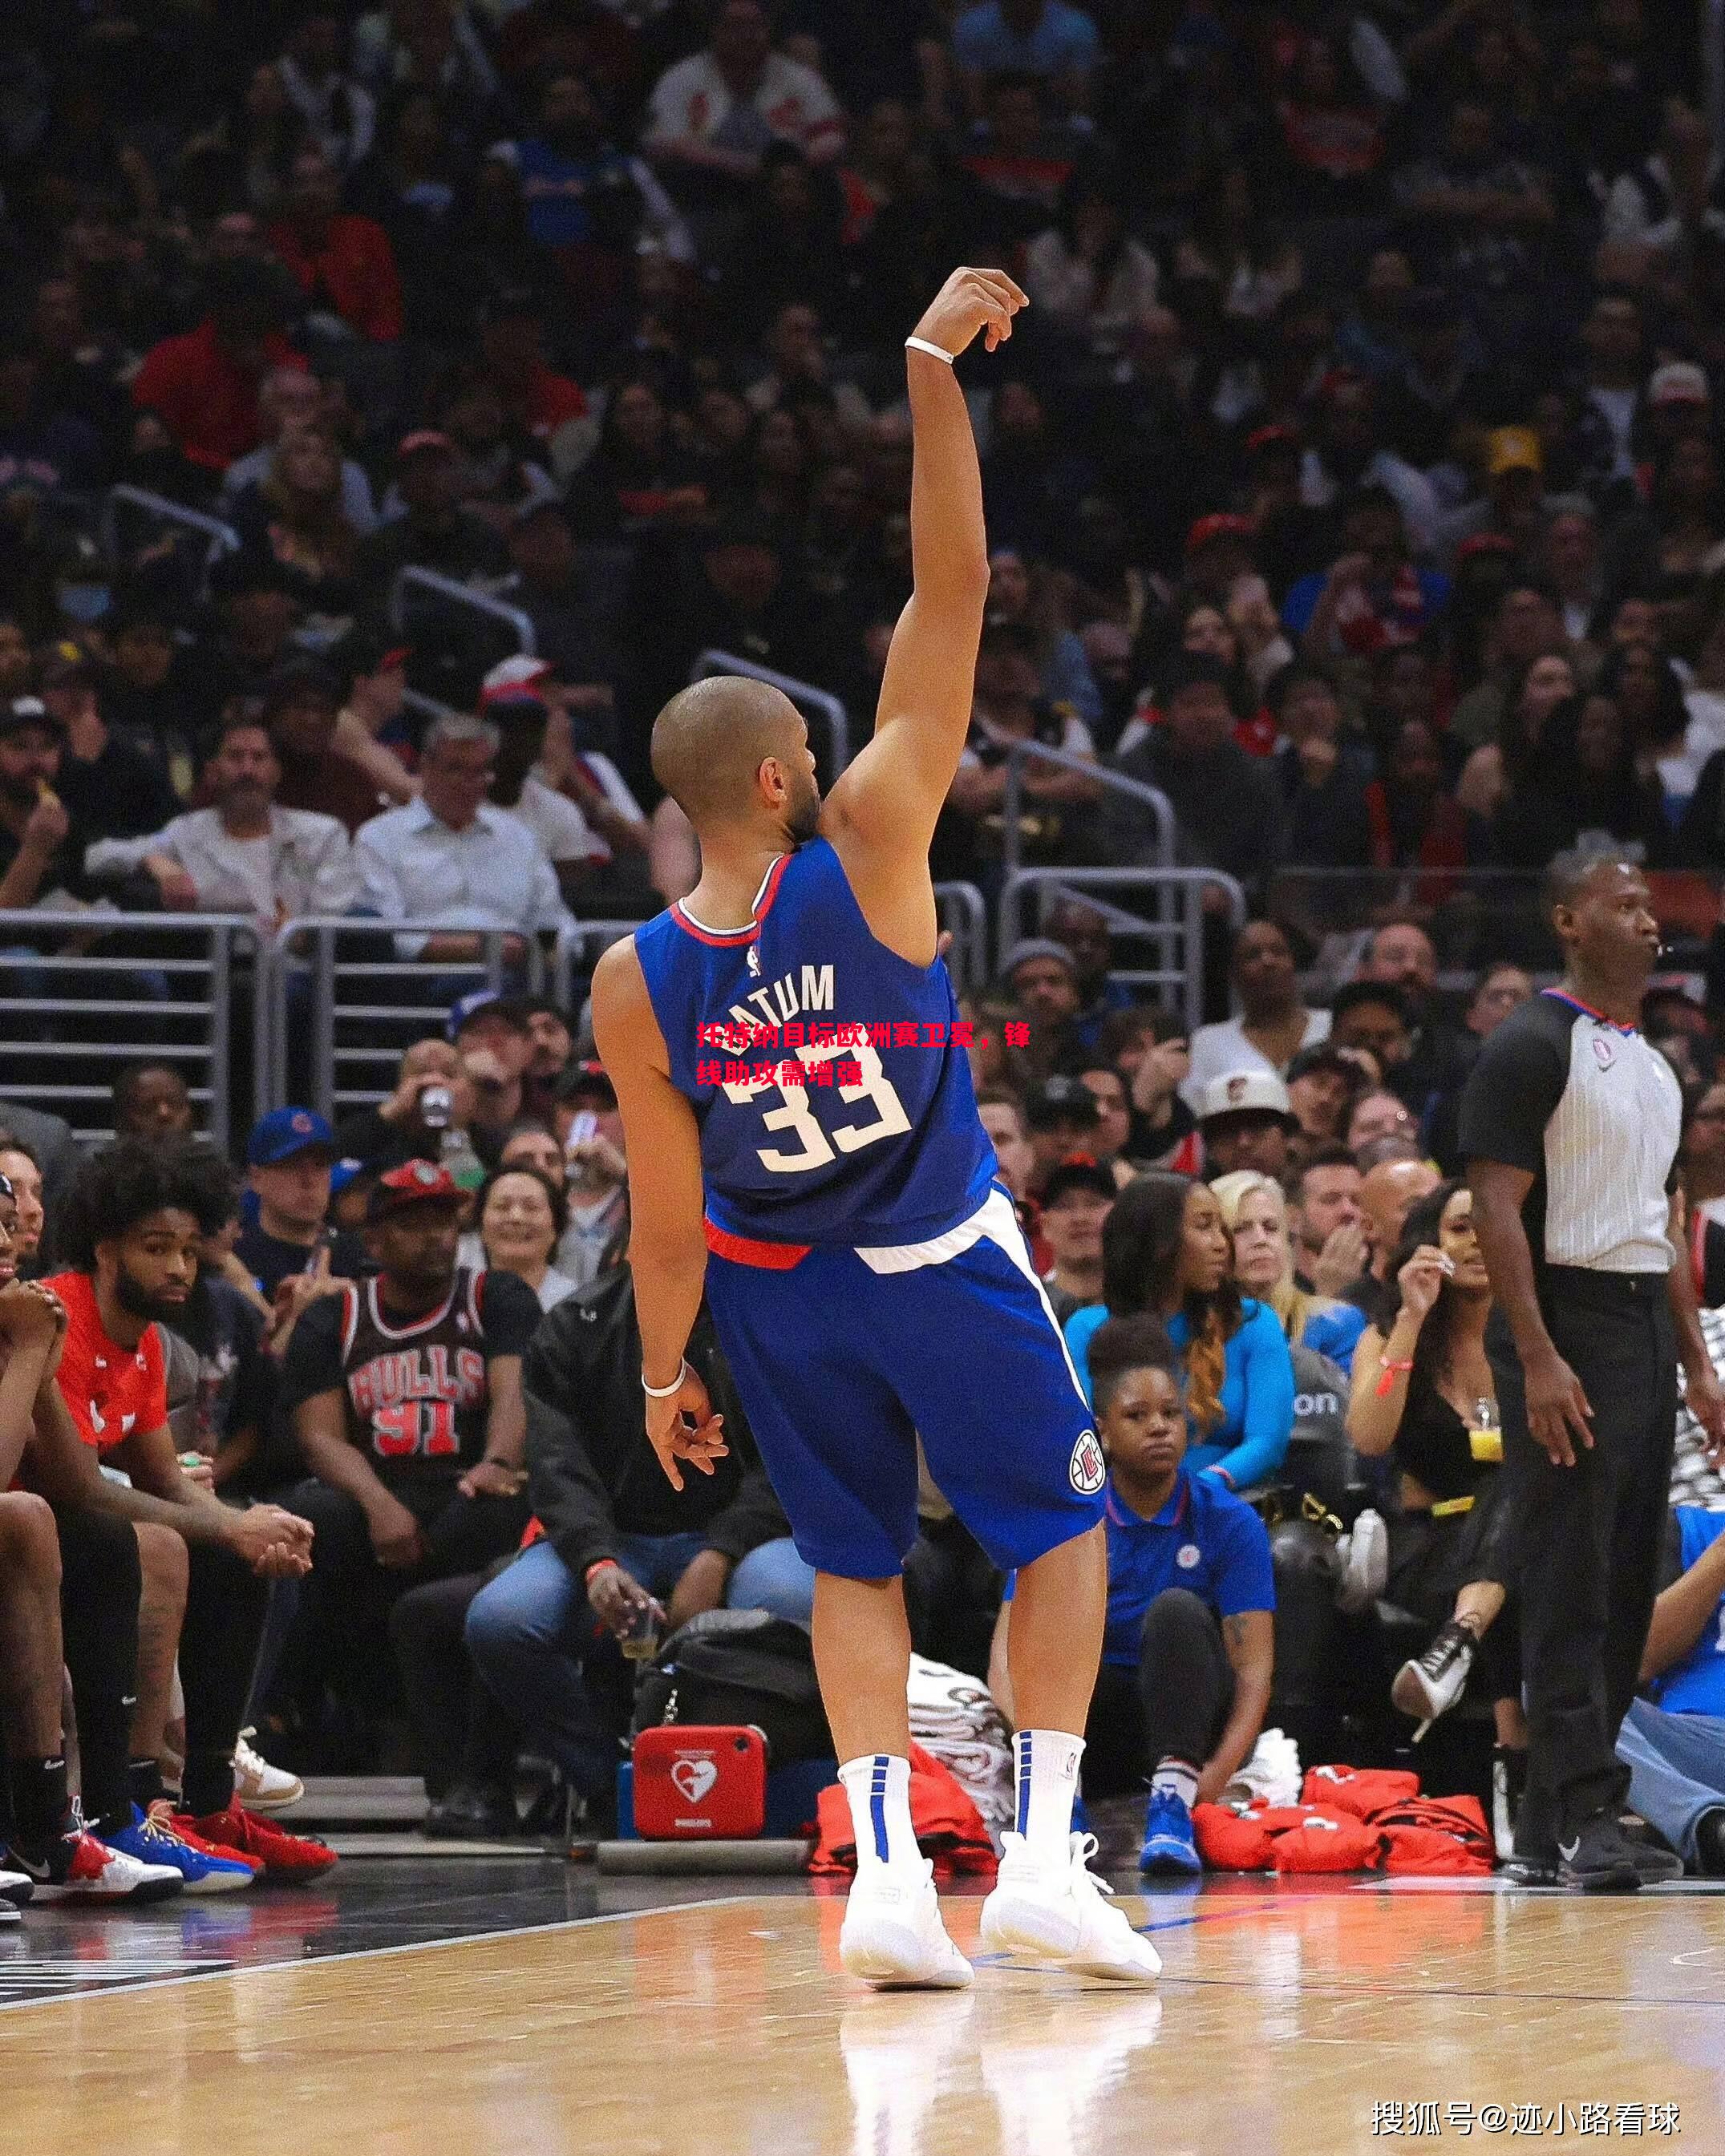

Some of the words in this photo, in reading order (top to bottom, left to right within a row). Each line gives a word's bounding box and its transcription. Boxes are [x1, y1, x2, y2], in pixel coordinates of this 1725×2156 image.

[721, 1022, 913, 1172] 33
[346, 1344, 486, 1418] BULLS
[371, 1400, 460, 1457] 91
